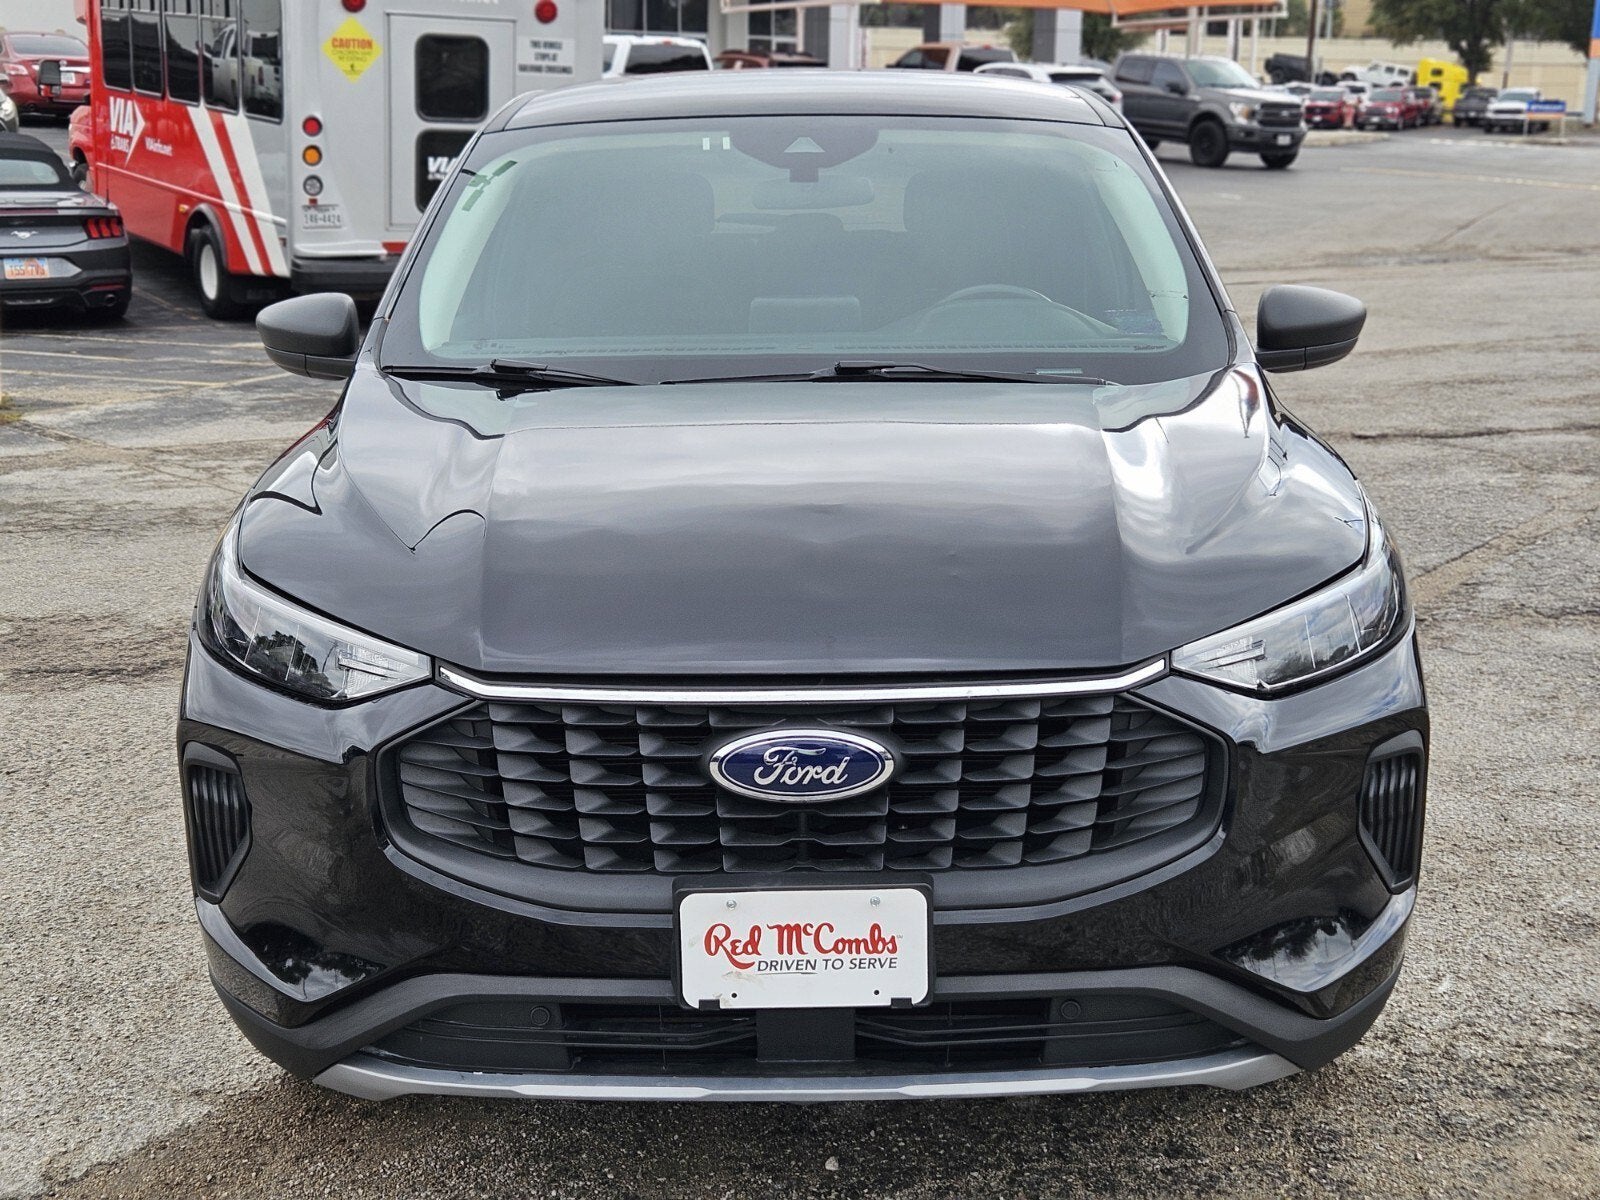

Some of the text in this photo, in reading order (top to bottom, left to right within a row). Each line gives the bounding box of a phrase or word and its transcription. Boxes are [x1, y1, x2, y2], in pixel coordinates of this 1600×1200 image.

[331, 38, 373, 50] CAUTION
[109, 96, 134, 138] VIA
[753, 746, 851, 785] Ford
[704, 922, 899, 969] Red McCombs
[757, 956, 898, 972] DRIVEN TO SERVE
